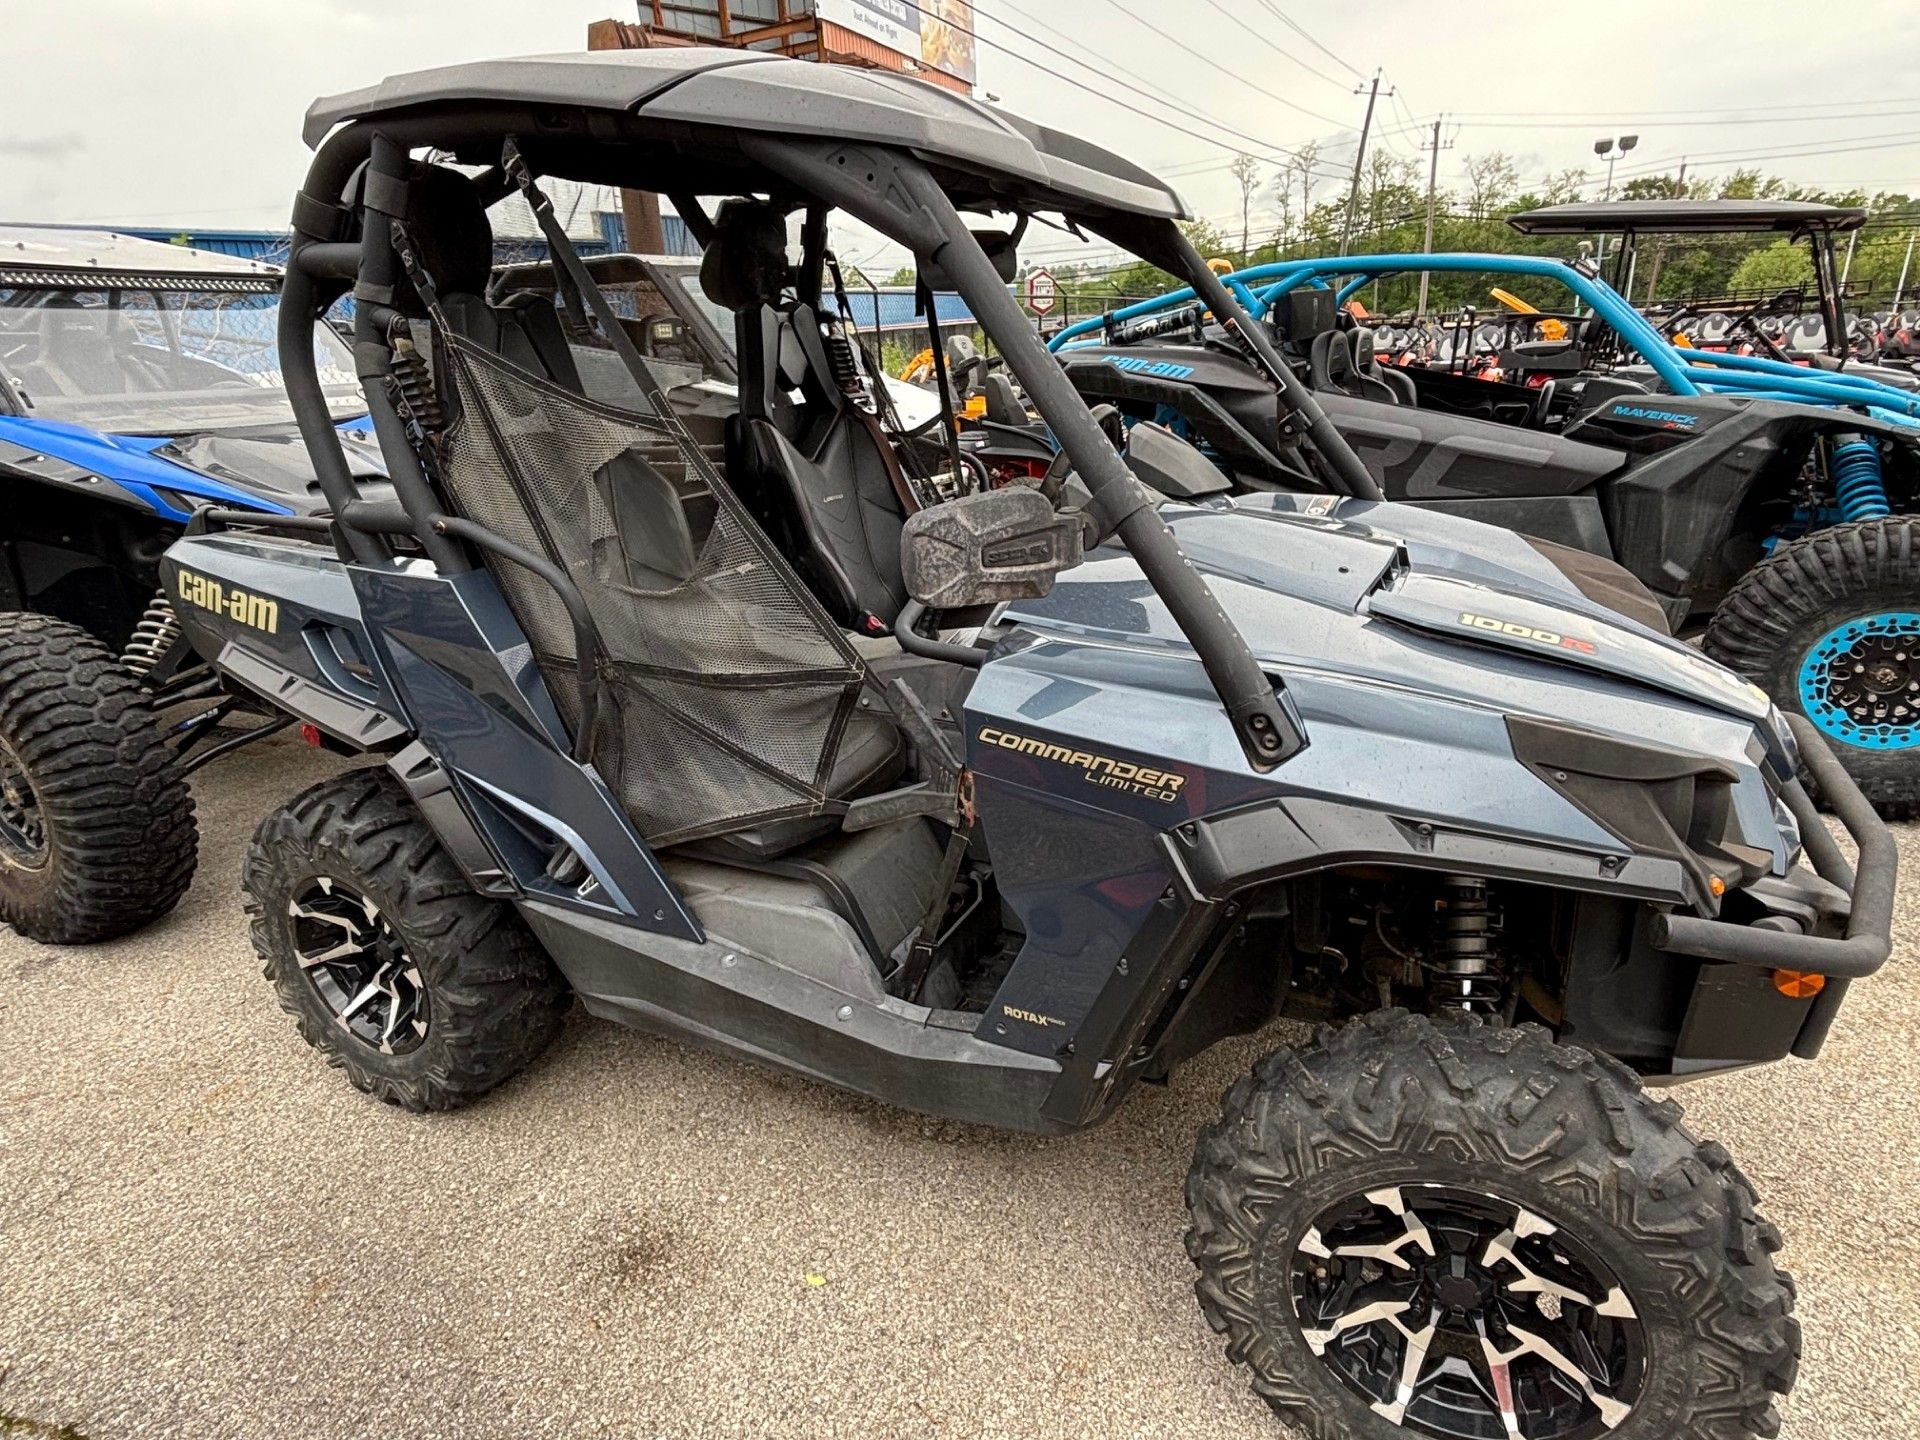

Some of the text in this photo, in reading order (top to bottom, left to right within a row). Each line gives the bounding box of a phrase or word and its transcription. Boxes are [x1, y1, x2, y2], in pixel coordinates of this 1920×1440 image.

[1613, 405, 1698, 424] MAVERICK
[178, 569, 278, 634] can-am
[979, 727, 1184, 791] COMMANDER
[1085, 770, 1177, 803] LIMITED
[1003, 1005, 1048, 1026] ROTAX
